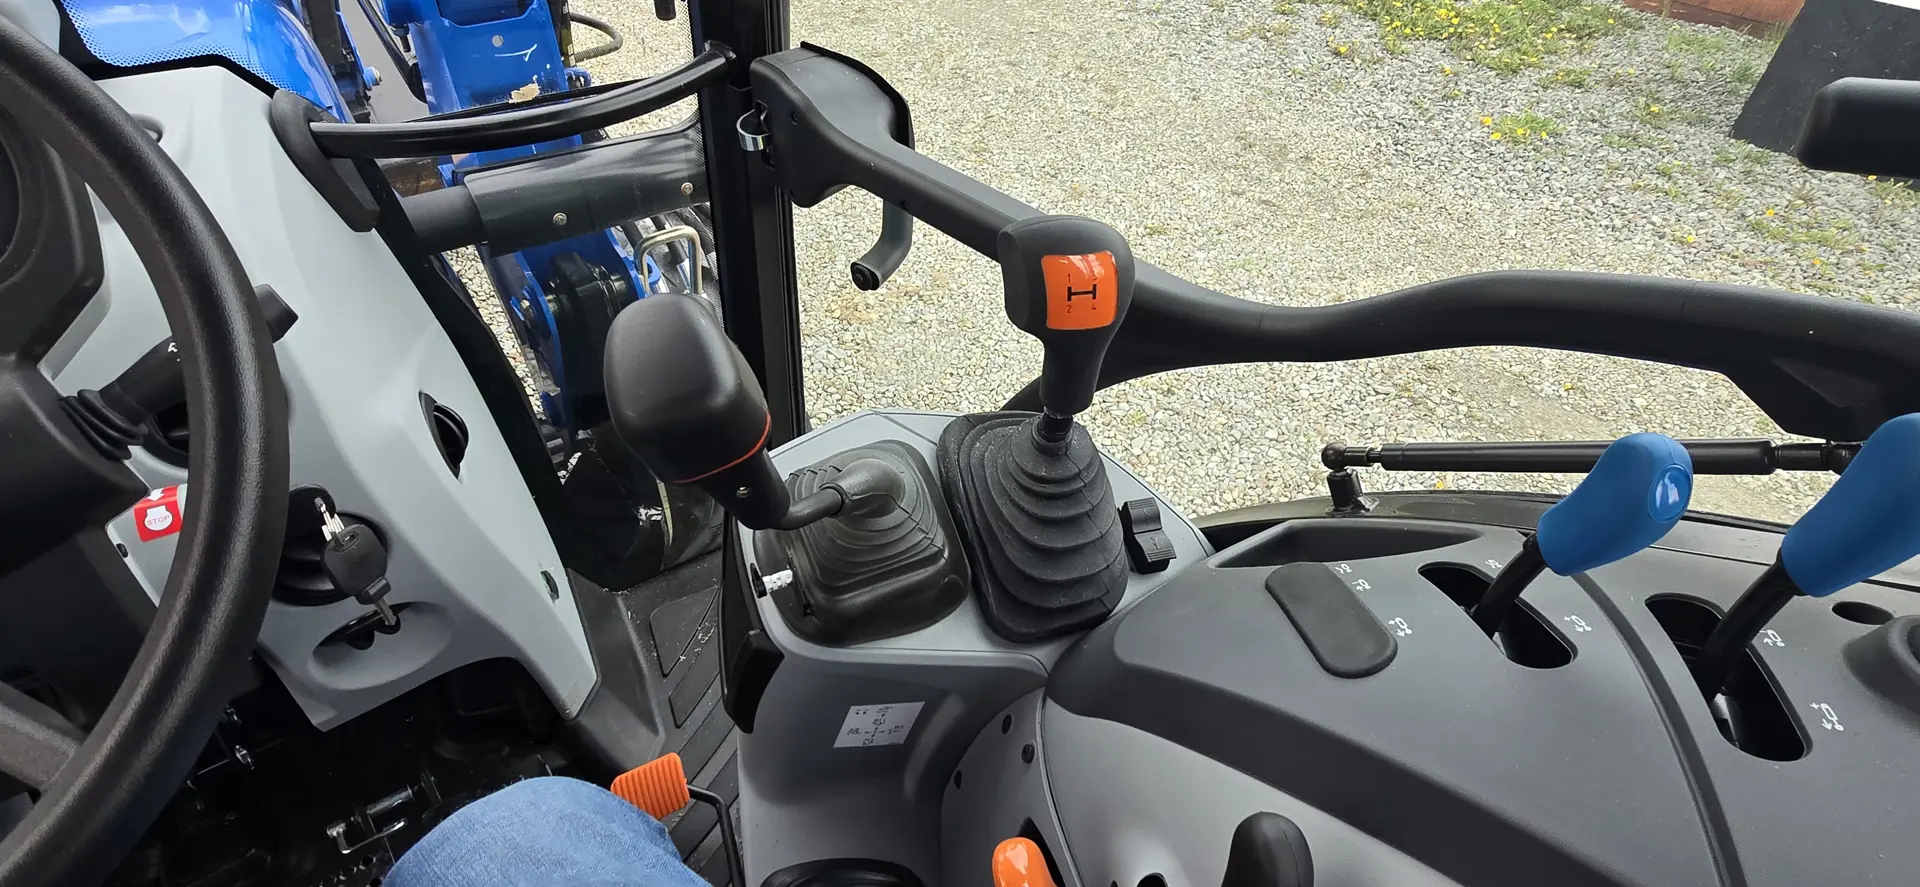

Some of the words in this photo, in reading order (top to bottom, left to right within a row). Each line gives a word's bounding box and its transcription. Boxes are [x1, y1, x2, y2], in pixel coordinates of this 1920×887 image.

[1067, 273, 1071, 283] 1
[1066, 304, 1072, 314] 2
[1091, 303, 1097, 311] 4
[146, 515, 170, 526] STOP
